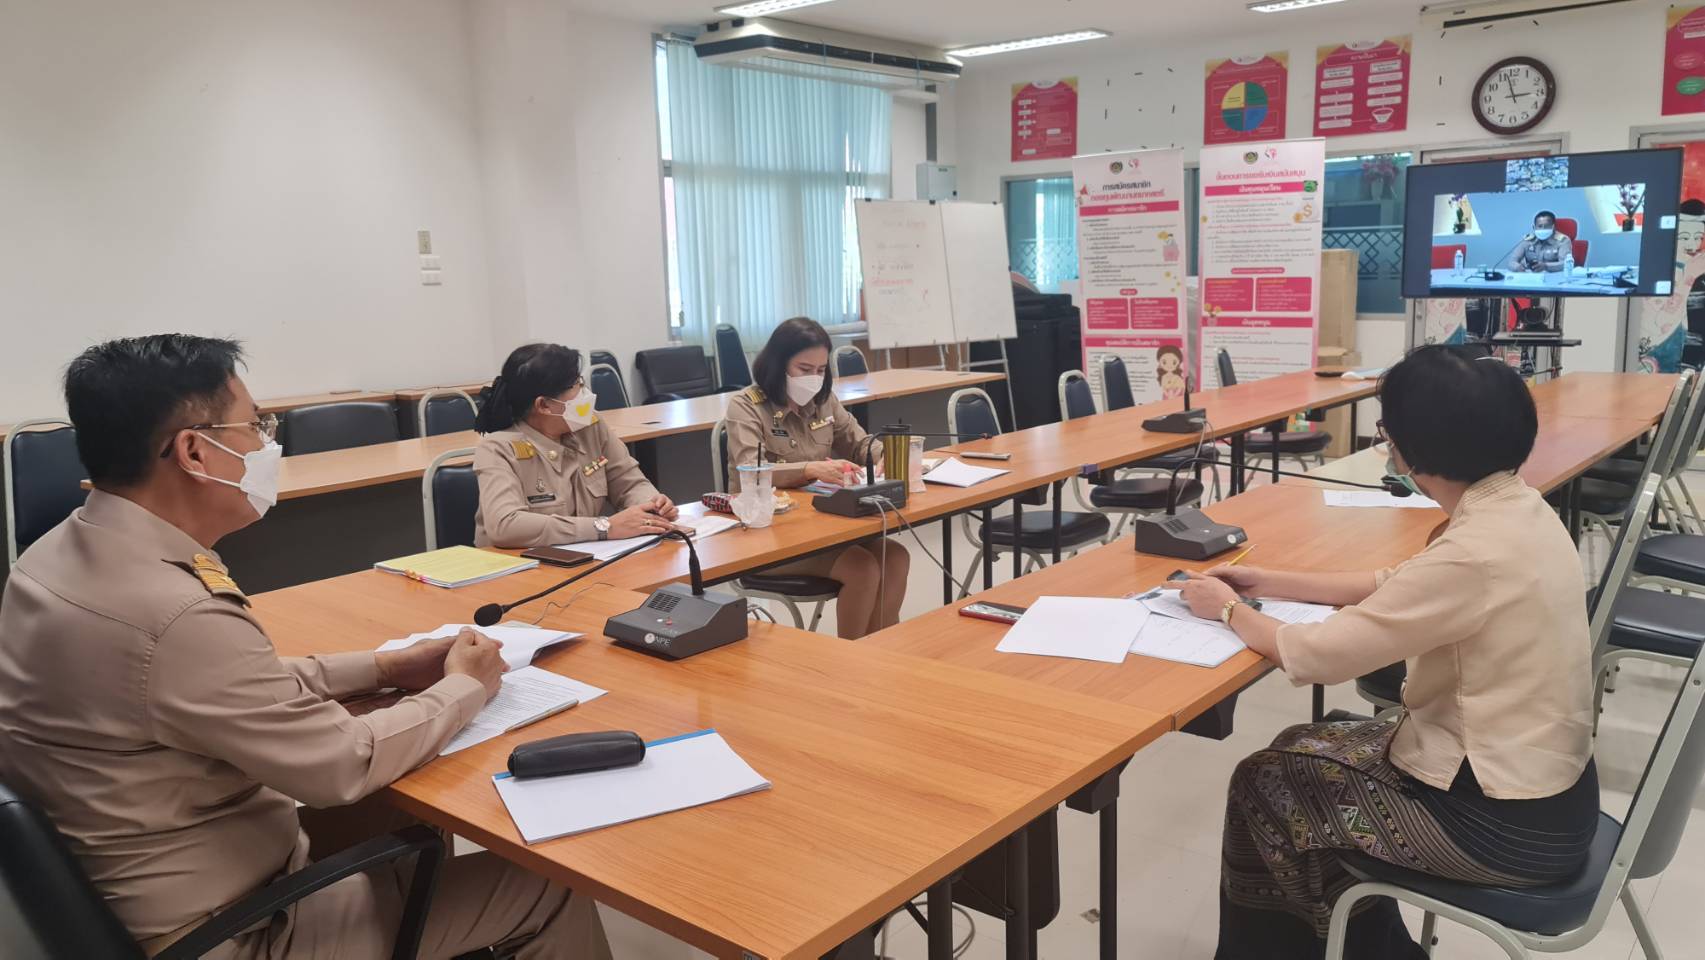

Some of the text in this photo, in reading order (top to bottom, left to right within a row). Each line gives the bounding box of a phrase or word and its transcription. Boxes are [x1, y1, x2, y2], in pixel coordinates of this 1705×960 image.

[1509, 68, 1520, 77] 12
[1499, 73, 1507, 82] 11
[1533, 77, 1541, 86] 2
[1489, 83, 1498, 92] 10
[1536, 88, 1544, 96] 3
[1484, 95, 1492, 104] 9
[1531, 100, 1538, 109] 4
[1488, 106, 1494, 114] 8
[1498, 113, 1504, 123] 7
[1509, 115, 1517, 124] 6
[1521, 111, 1529, 120] 5
